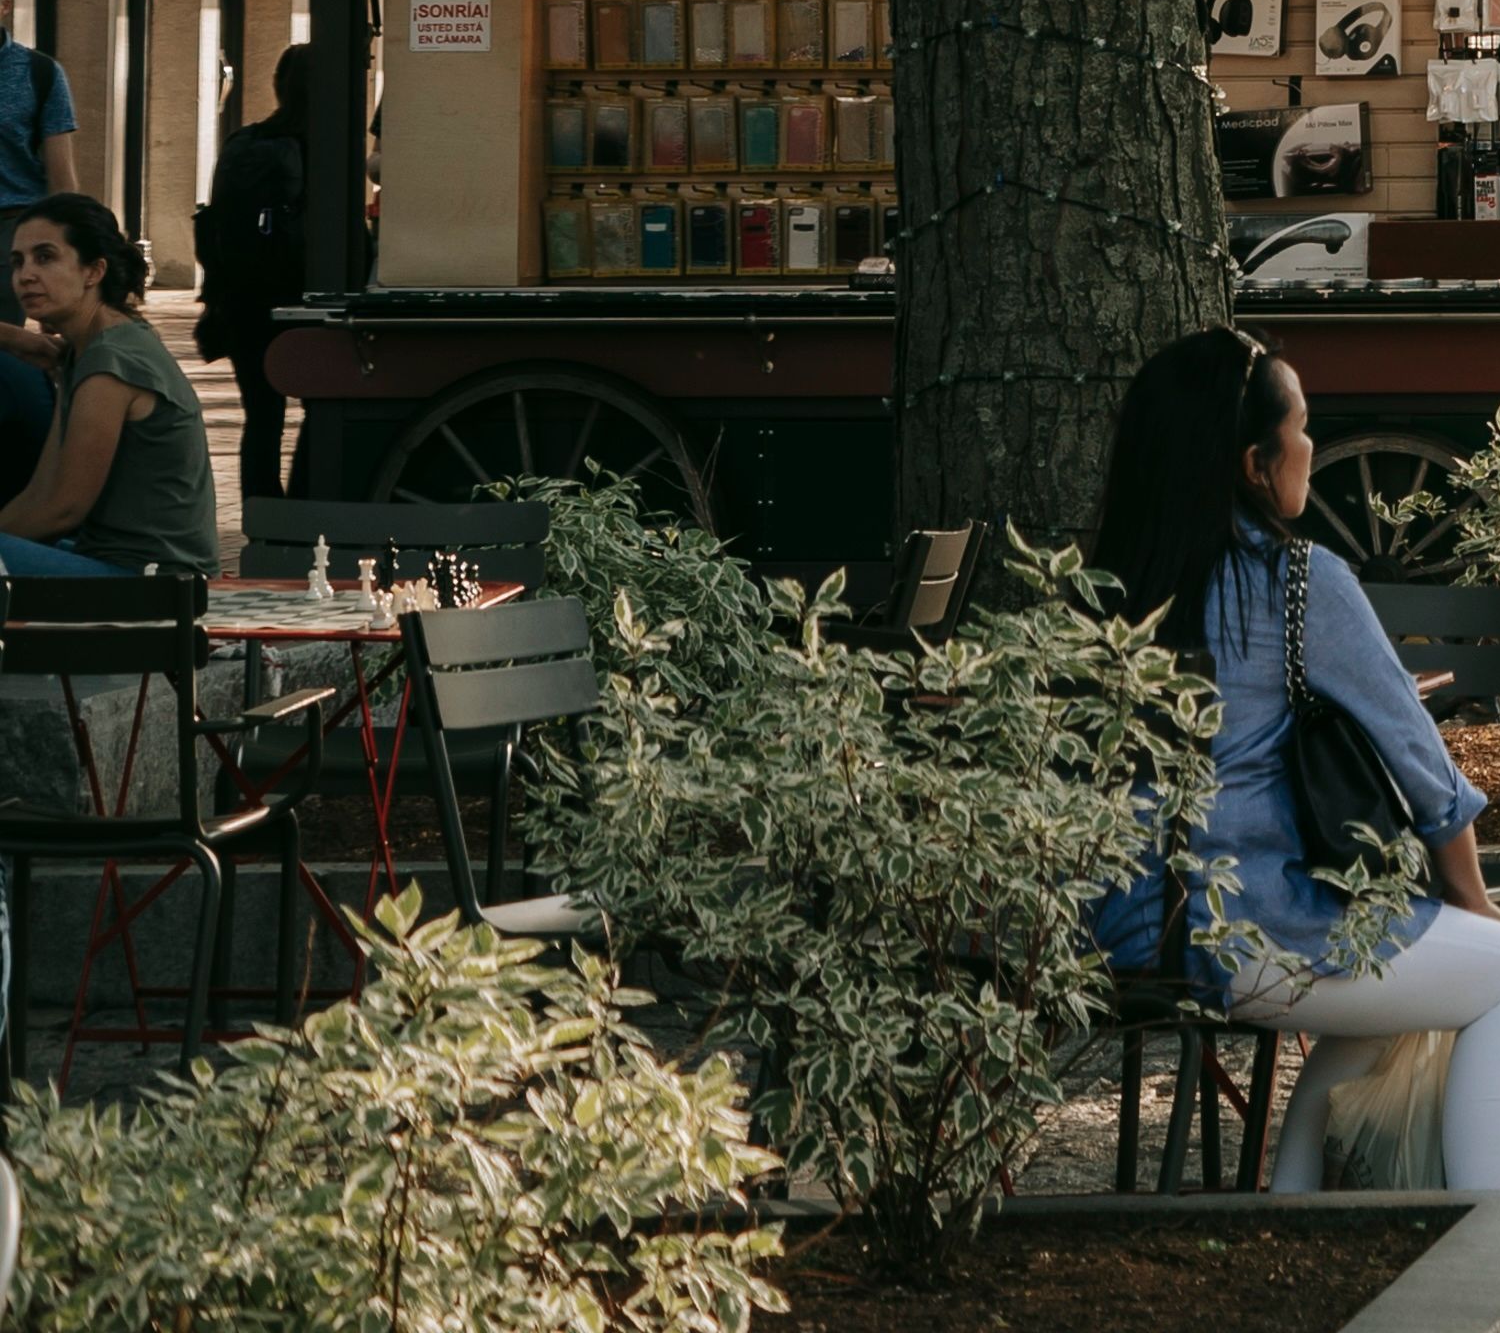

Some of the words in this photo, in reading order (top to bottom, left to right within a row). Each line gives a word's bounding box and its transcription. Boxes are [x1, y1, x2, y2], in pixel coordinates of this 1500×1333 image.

[413, 1, 488, 21] ¡SONRÍA!
[417, 23, 452, 33] USTED
[455, 21, 483, 33] ESTÁ
[418, 35, 433, 45] EN
[435, 33, 482, 45] CÁMARA
[1221, 117, 1280, 130] Medicpad
